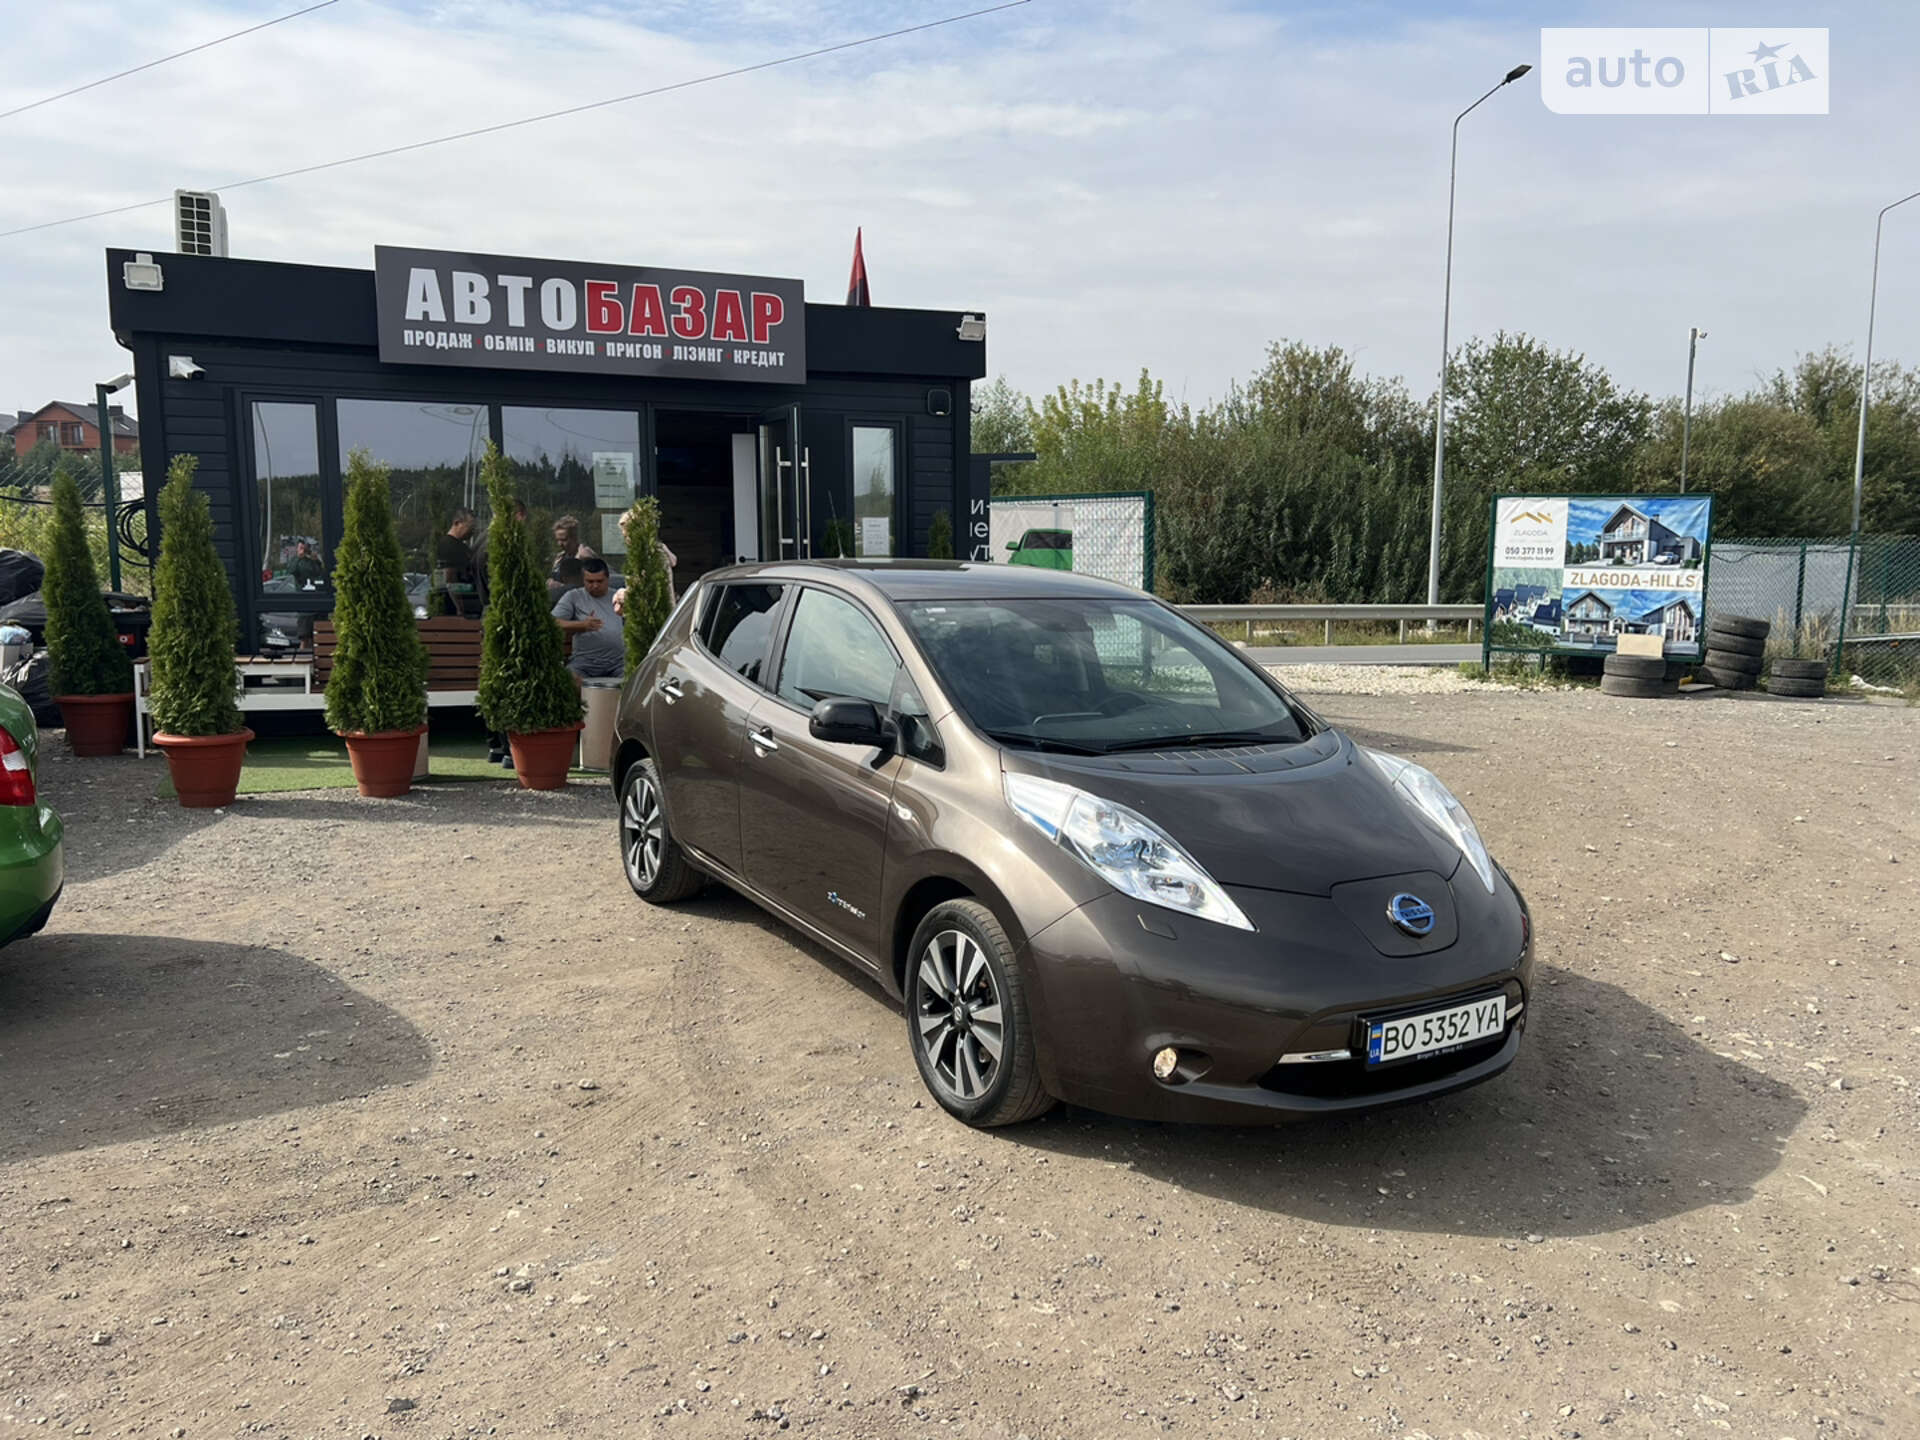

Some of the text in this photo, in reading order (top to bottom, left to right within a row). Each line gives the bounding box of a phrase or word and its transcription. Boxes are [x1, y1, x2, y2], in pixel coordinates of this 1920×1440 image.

[404, 267, 784, 344] АВТОБАЗАР
[403, 329, 786, 368] ПРОДАЖ ОБМІН ВИКУП ПРИГОН ЛІЗИНГ КРЕДИТ
[1505, 546, 1520, 555] 050
[1570, 572, 1697, 588] ZLAGODA-HILLS
[1383, 1023, 1417, 1056] BO
[1421, 1010, 1470, 1047] 5352
[1475, 1002, 1499, 1034] YA
